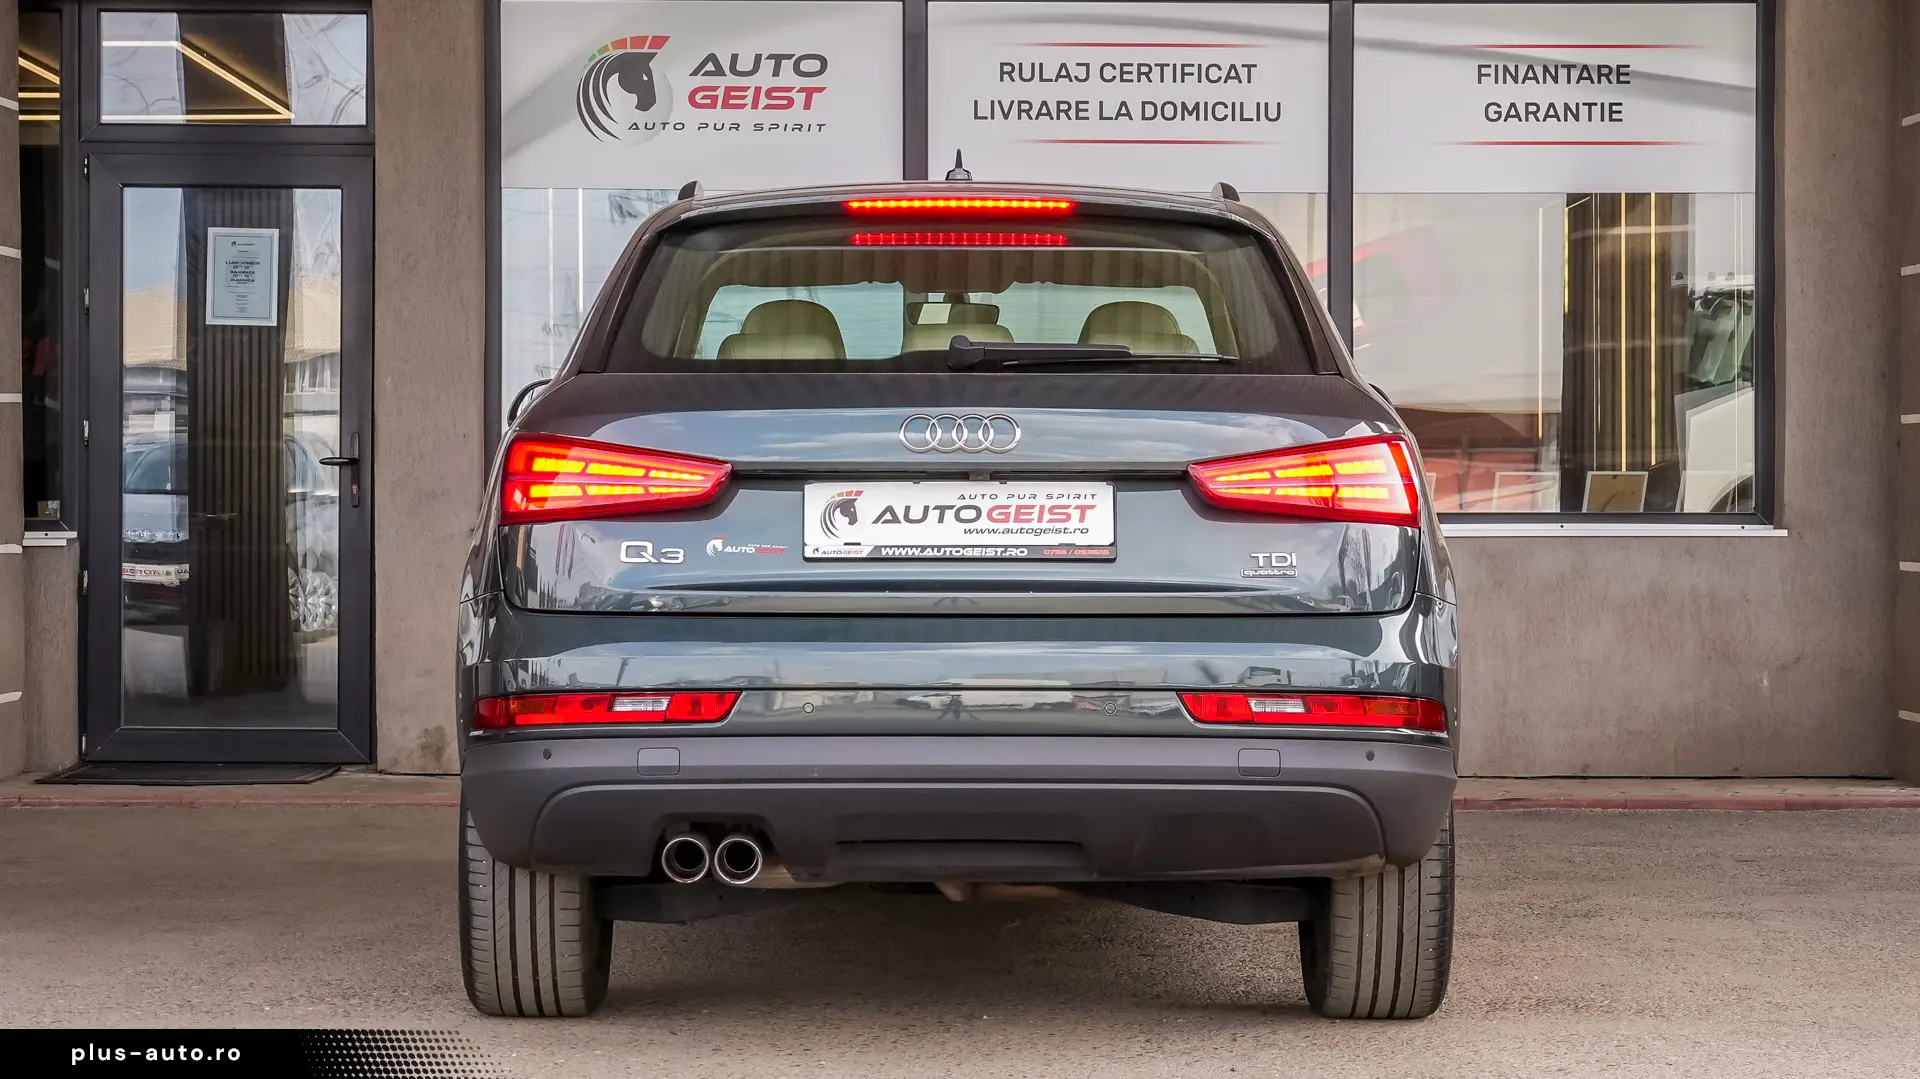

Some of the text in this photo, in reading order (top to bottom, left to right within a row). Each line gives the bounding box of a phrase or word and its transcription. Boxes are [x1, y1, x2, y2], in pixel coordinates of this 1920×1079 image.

[688, 53, 829, 78] AUTO
[999, 62, 1257, 84] RULAJ CERTIFICAT
[1477, 64, 1631, 85] FINANTARE
[687, 86, 828, 110] GEIST
[973, 100, 1282, 122] LIVRARE LA DOMICILIU
[1484, 102, 1623, 123] GARANTIE
[627, 122, 827, 132] AUTO PUR SPIRIT
[871, 504, 1096, 524] AUTOGEIST
[963, 526, 1090, 537] www.autogeist.ro
[881, 547, 1028, 556] WWW.AUTOGEIST.RO
[1250, 552, 1297, 568] TDI
